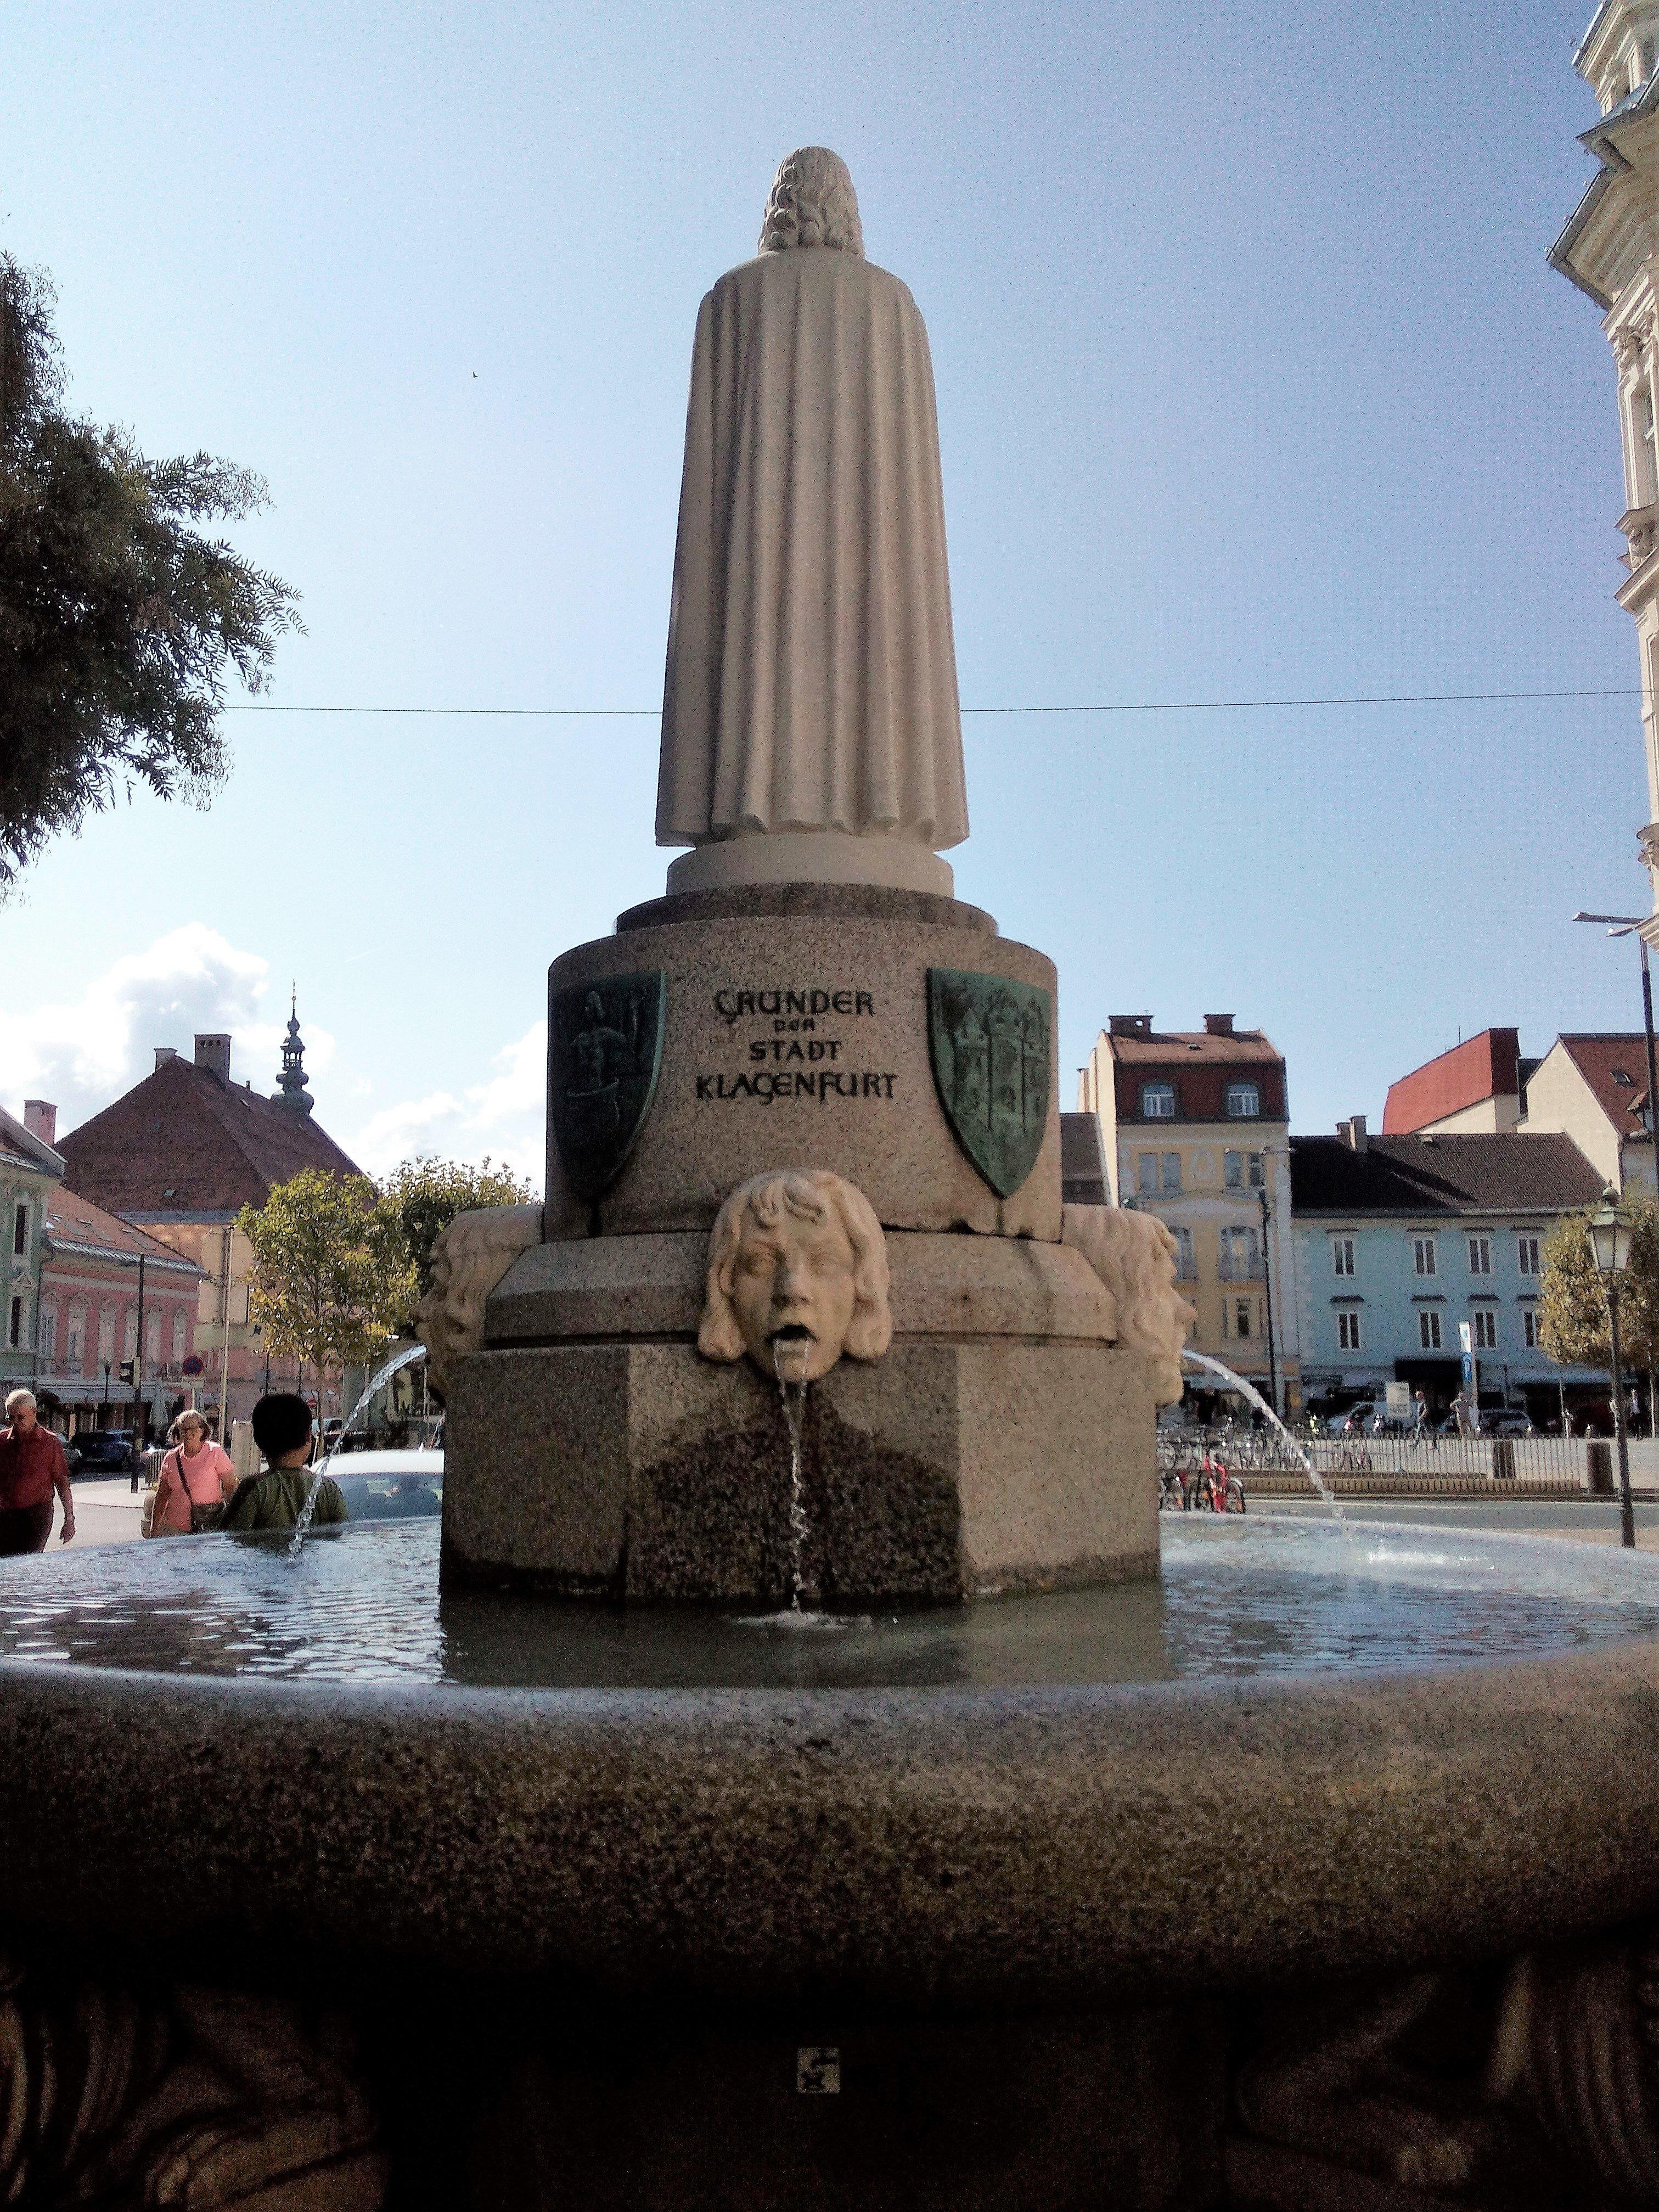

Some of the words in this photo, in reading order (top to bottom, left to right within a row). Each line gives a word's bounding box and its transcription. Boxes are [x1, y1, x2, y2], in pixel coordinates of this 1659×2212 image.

[774, 1018, 816, 1032] DER
[750, 1041, 841, 1060] STADT
[696, 1072, 898, 1105] KLAGENFURT
